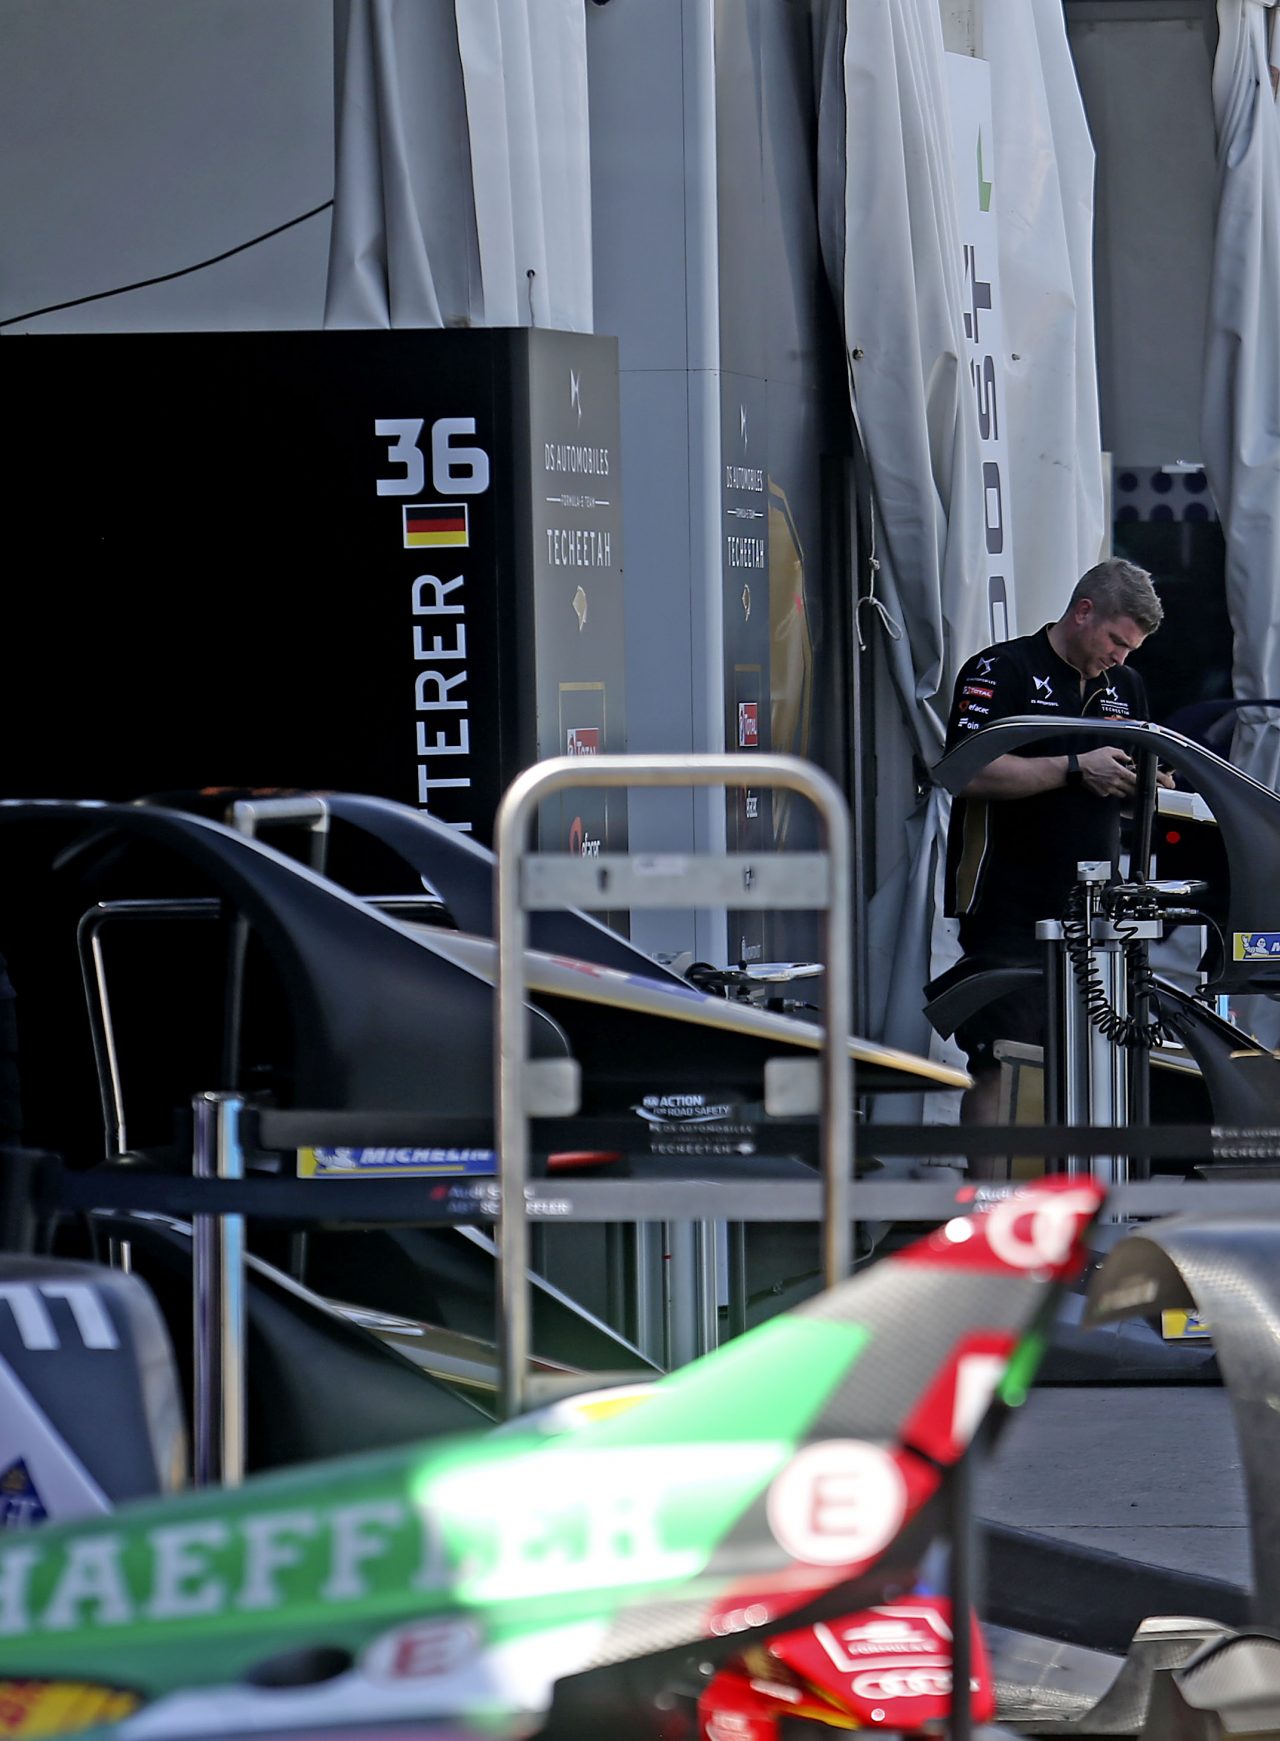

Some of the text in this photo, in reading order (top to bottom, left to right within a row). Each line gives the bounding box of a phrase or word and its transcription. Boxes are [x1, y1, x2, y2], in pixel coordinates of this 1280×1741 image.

[375, 417, 490, 496] 36
[544, 443, 609, 475] DS AUTOMOBILES
[546, 528, 611, 567] TECHEETAH
[727, 536, 765, 568] TECHEETAH
[968, 704, 990, 715] efacec
[660, 1095, 702, 1107] ACTION
[667, 1107, 694, 1116] ROAD
[695, 1105, 729, 1115] SAFETY
[810, 1472, 860, 1538] E
